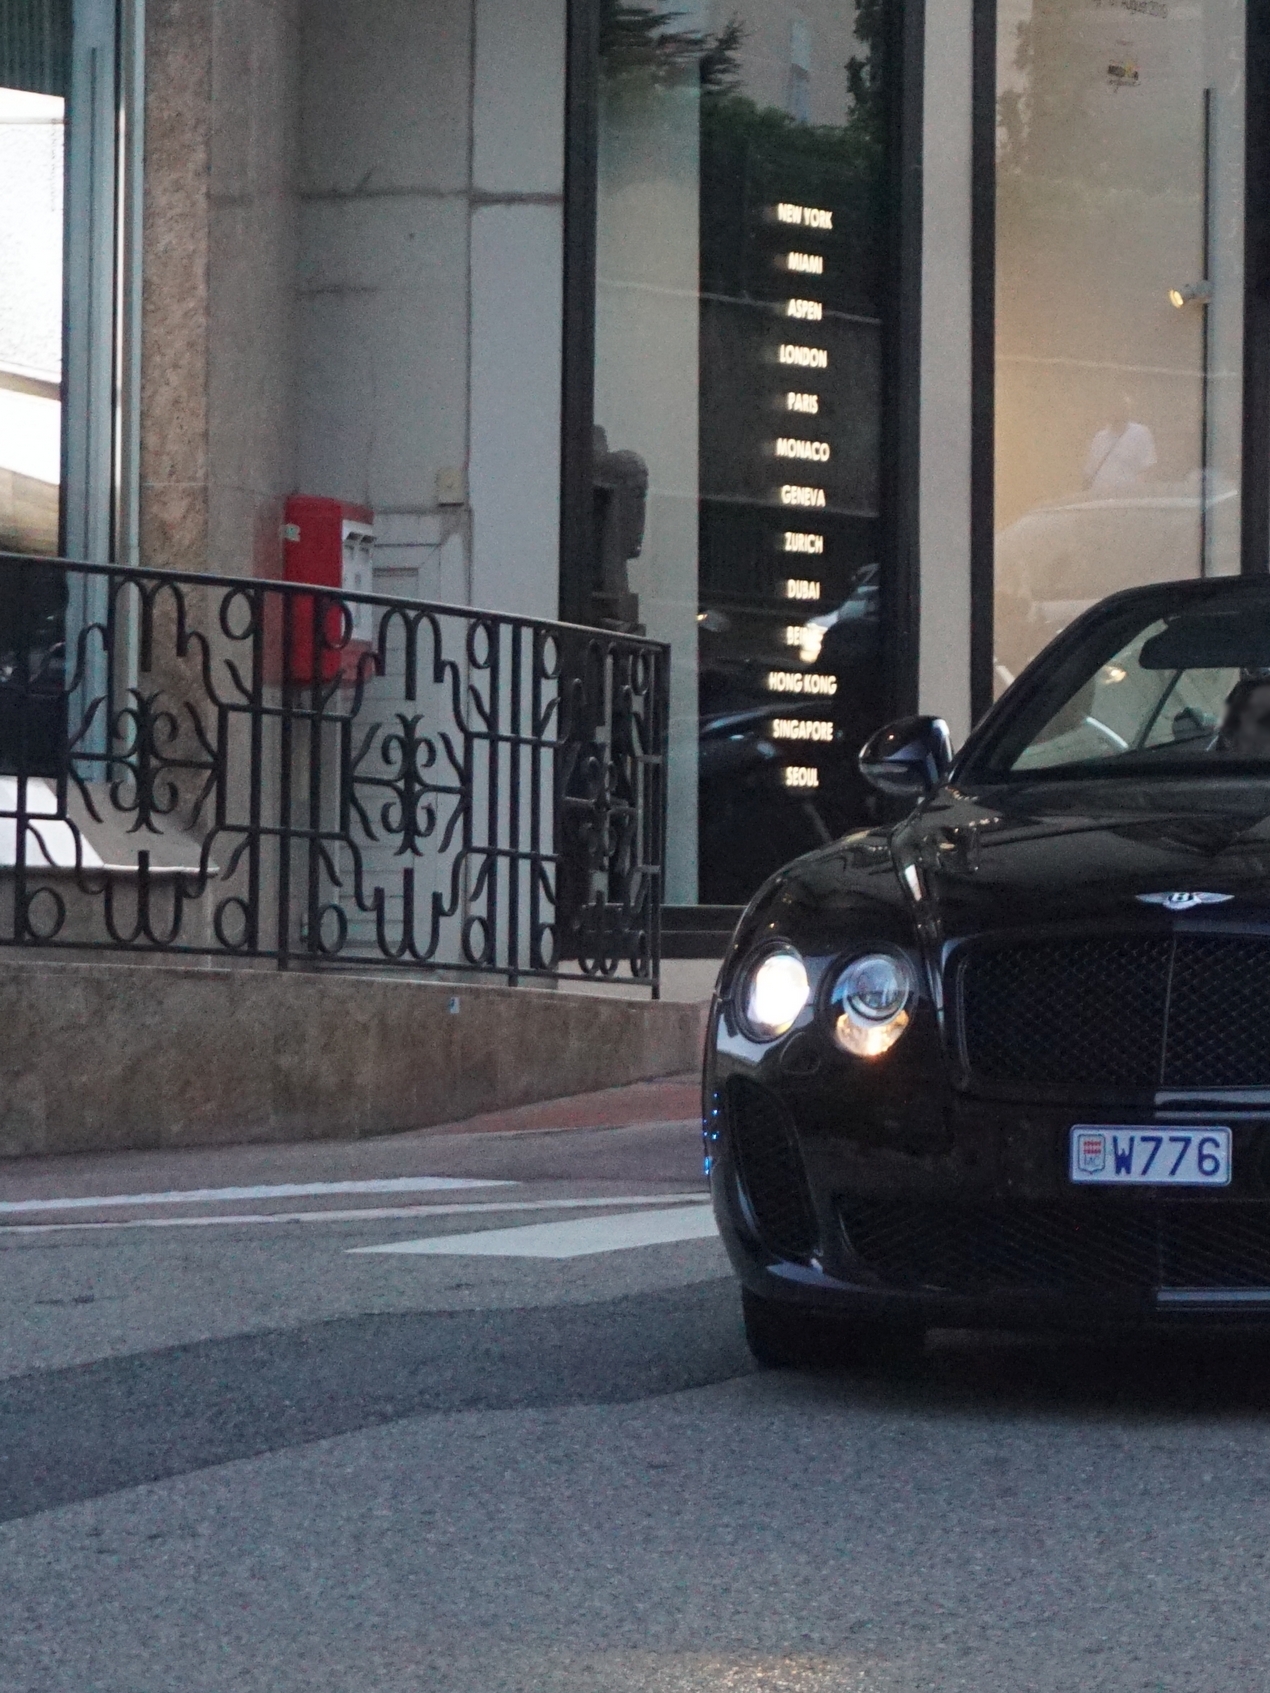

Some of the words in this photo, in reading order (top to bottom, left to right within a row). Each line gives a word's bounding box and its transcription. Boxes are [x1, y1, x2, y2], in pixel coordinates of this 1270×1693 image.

[777, 203, 803, 225] NEW
[803, 206, 833, 230] YORK
[786, 252, 823, 275] MIAMI
[786, 298, 823, 321] ASPEN
[778, 344, 828, 369] LONDON
[786, 391, 819, 415] PARIS
[775, 437, 831, 462] MONACO
[780, 484, 826, 508] GENEVA
[784, 531, 824, 554] ZURICH
[786, 579, 821, 600] DUBAI
[768, 671, 803, 693] HONG
[803, 674, 838, 696] KONG
[772, 718, 834, 742] SINGAPORE
[785, 766, 819, 787] SEOUL
[1112, 1135, 1221, 1177] W776
